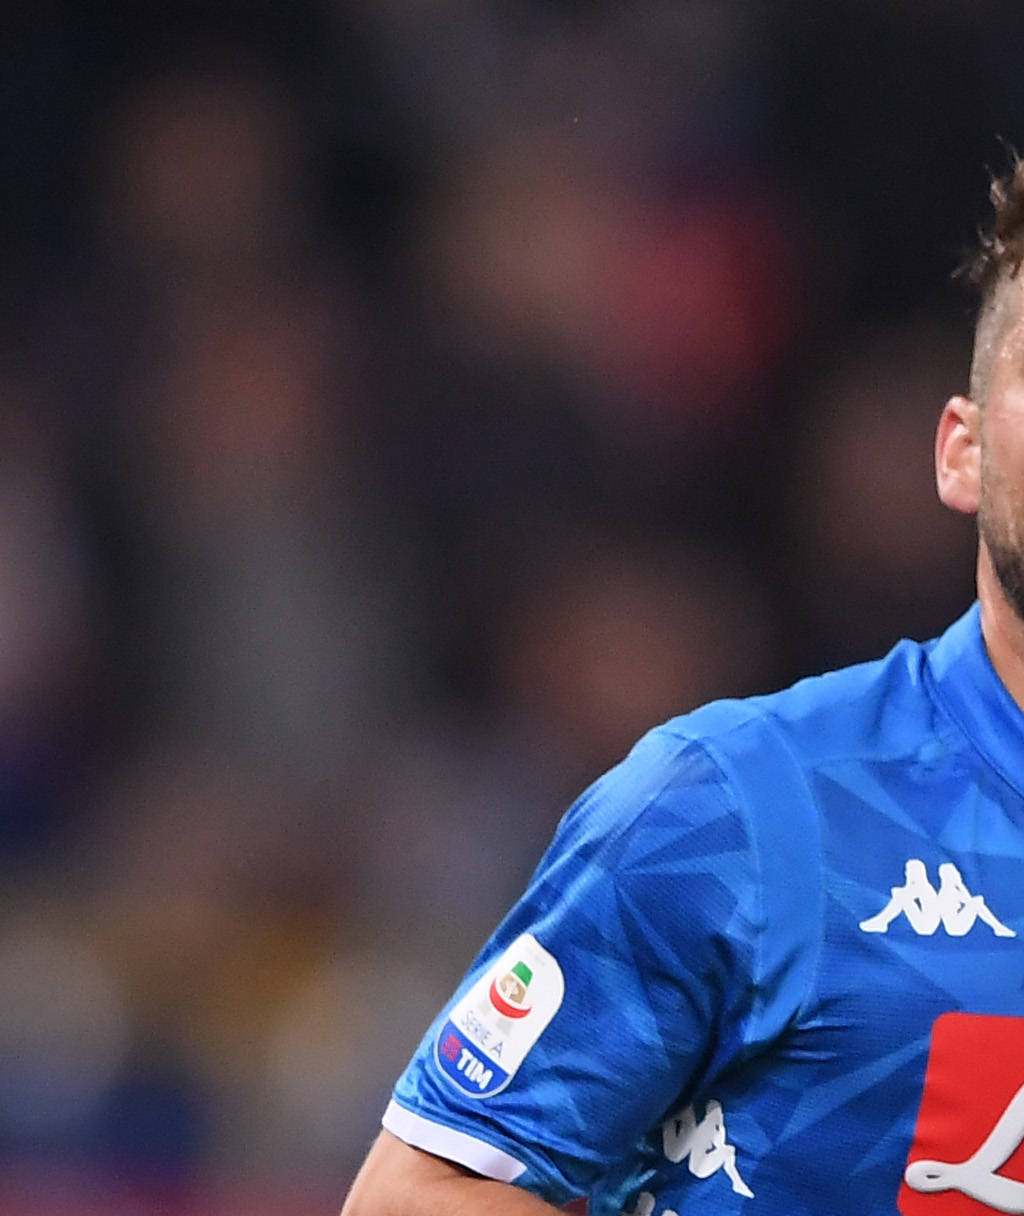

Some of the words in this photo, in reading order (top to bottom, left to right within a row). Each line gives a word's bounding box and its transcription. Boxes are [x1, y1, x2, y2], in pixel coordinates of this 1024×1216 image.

[461, 1009, 493, 1046] SERIE
[489, 1041, 503, 1058] A
[457, 1047, 493, 1090] TIM
